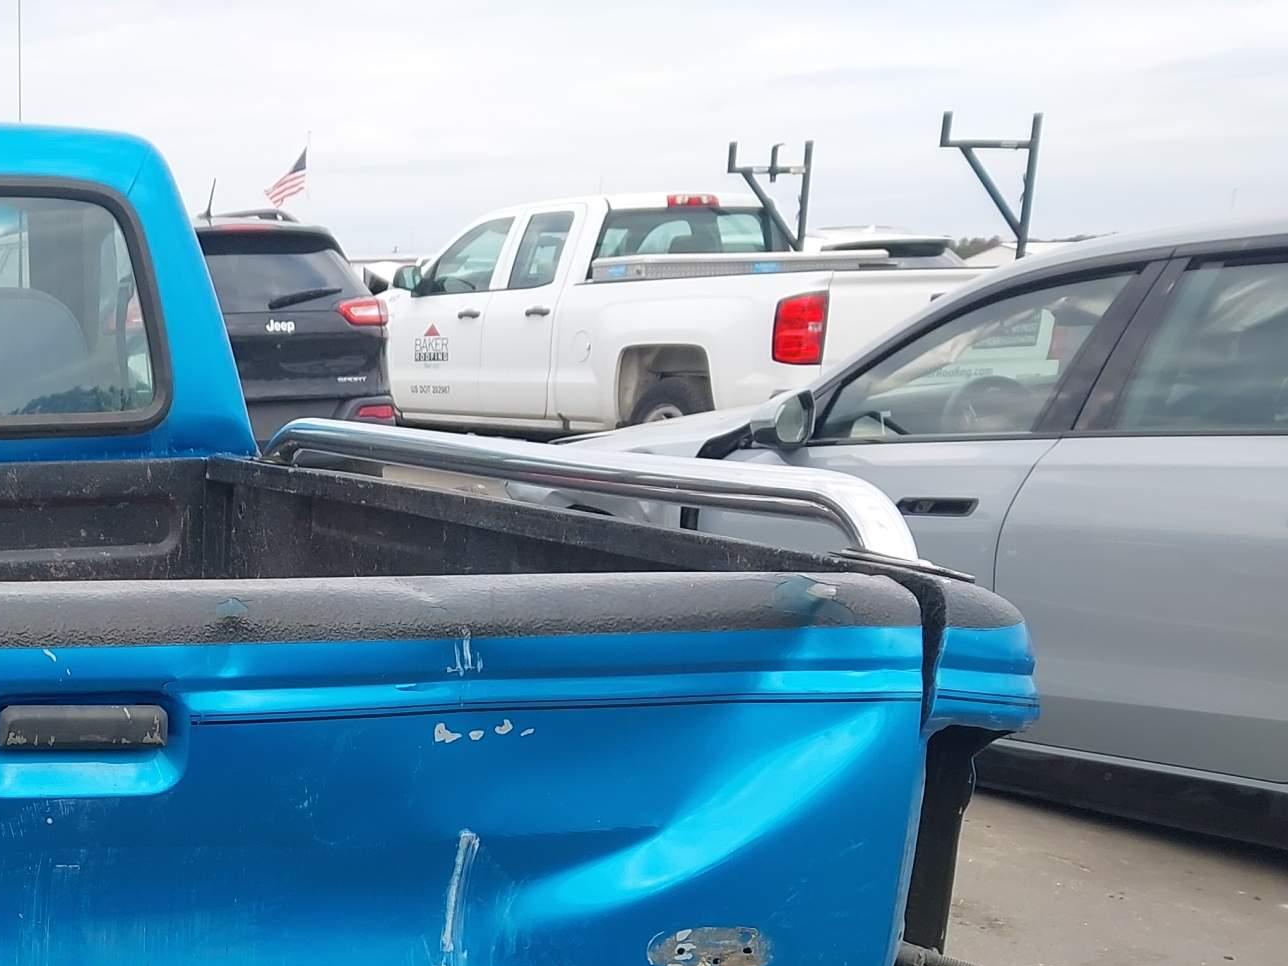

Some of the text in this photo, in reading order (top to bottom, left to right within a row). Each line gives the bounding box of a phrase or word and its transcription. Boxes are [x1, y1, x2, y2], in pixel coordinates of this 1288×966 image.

[265, 319, 295, 334] Jeep
[415, 337, 449, 352] BAKER
[419, 385, 430, 394] DOT
